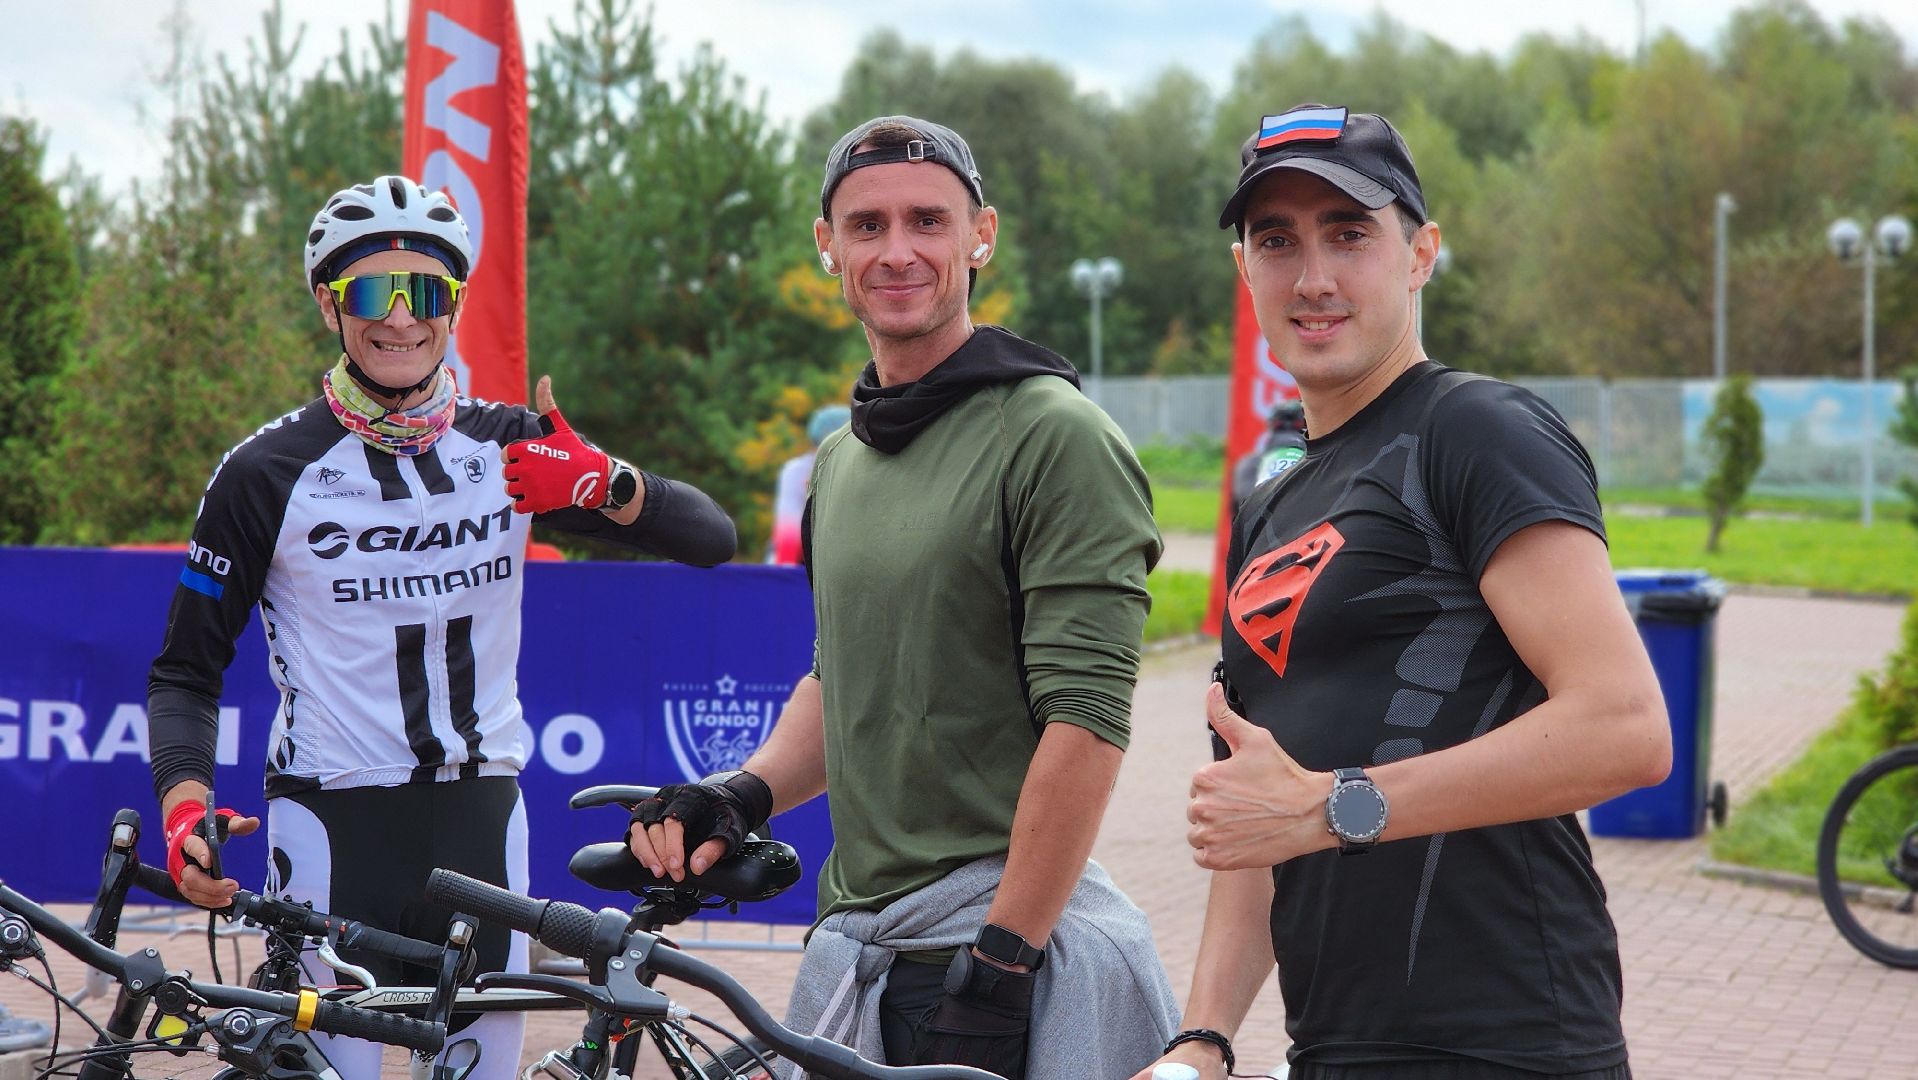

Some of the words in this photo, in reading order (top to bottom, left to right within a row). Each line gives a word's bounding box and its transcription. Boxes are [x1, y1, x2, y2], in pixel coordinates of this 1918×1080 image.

[356, 504, 512, 552] GIANT
[332, 556, 512, 603] SHIMANO
[694, 700, 759, 712] GRAN
[694, 714, 760, 727] FONDO
